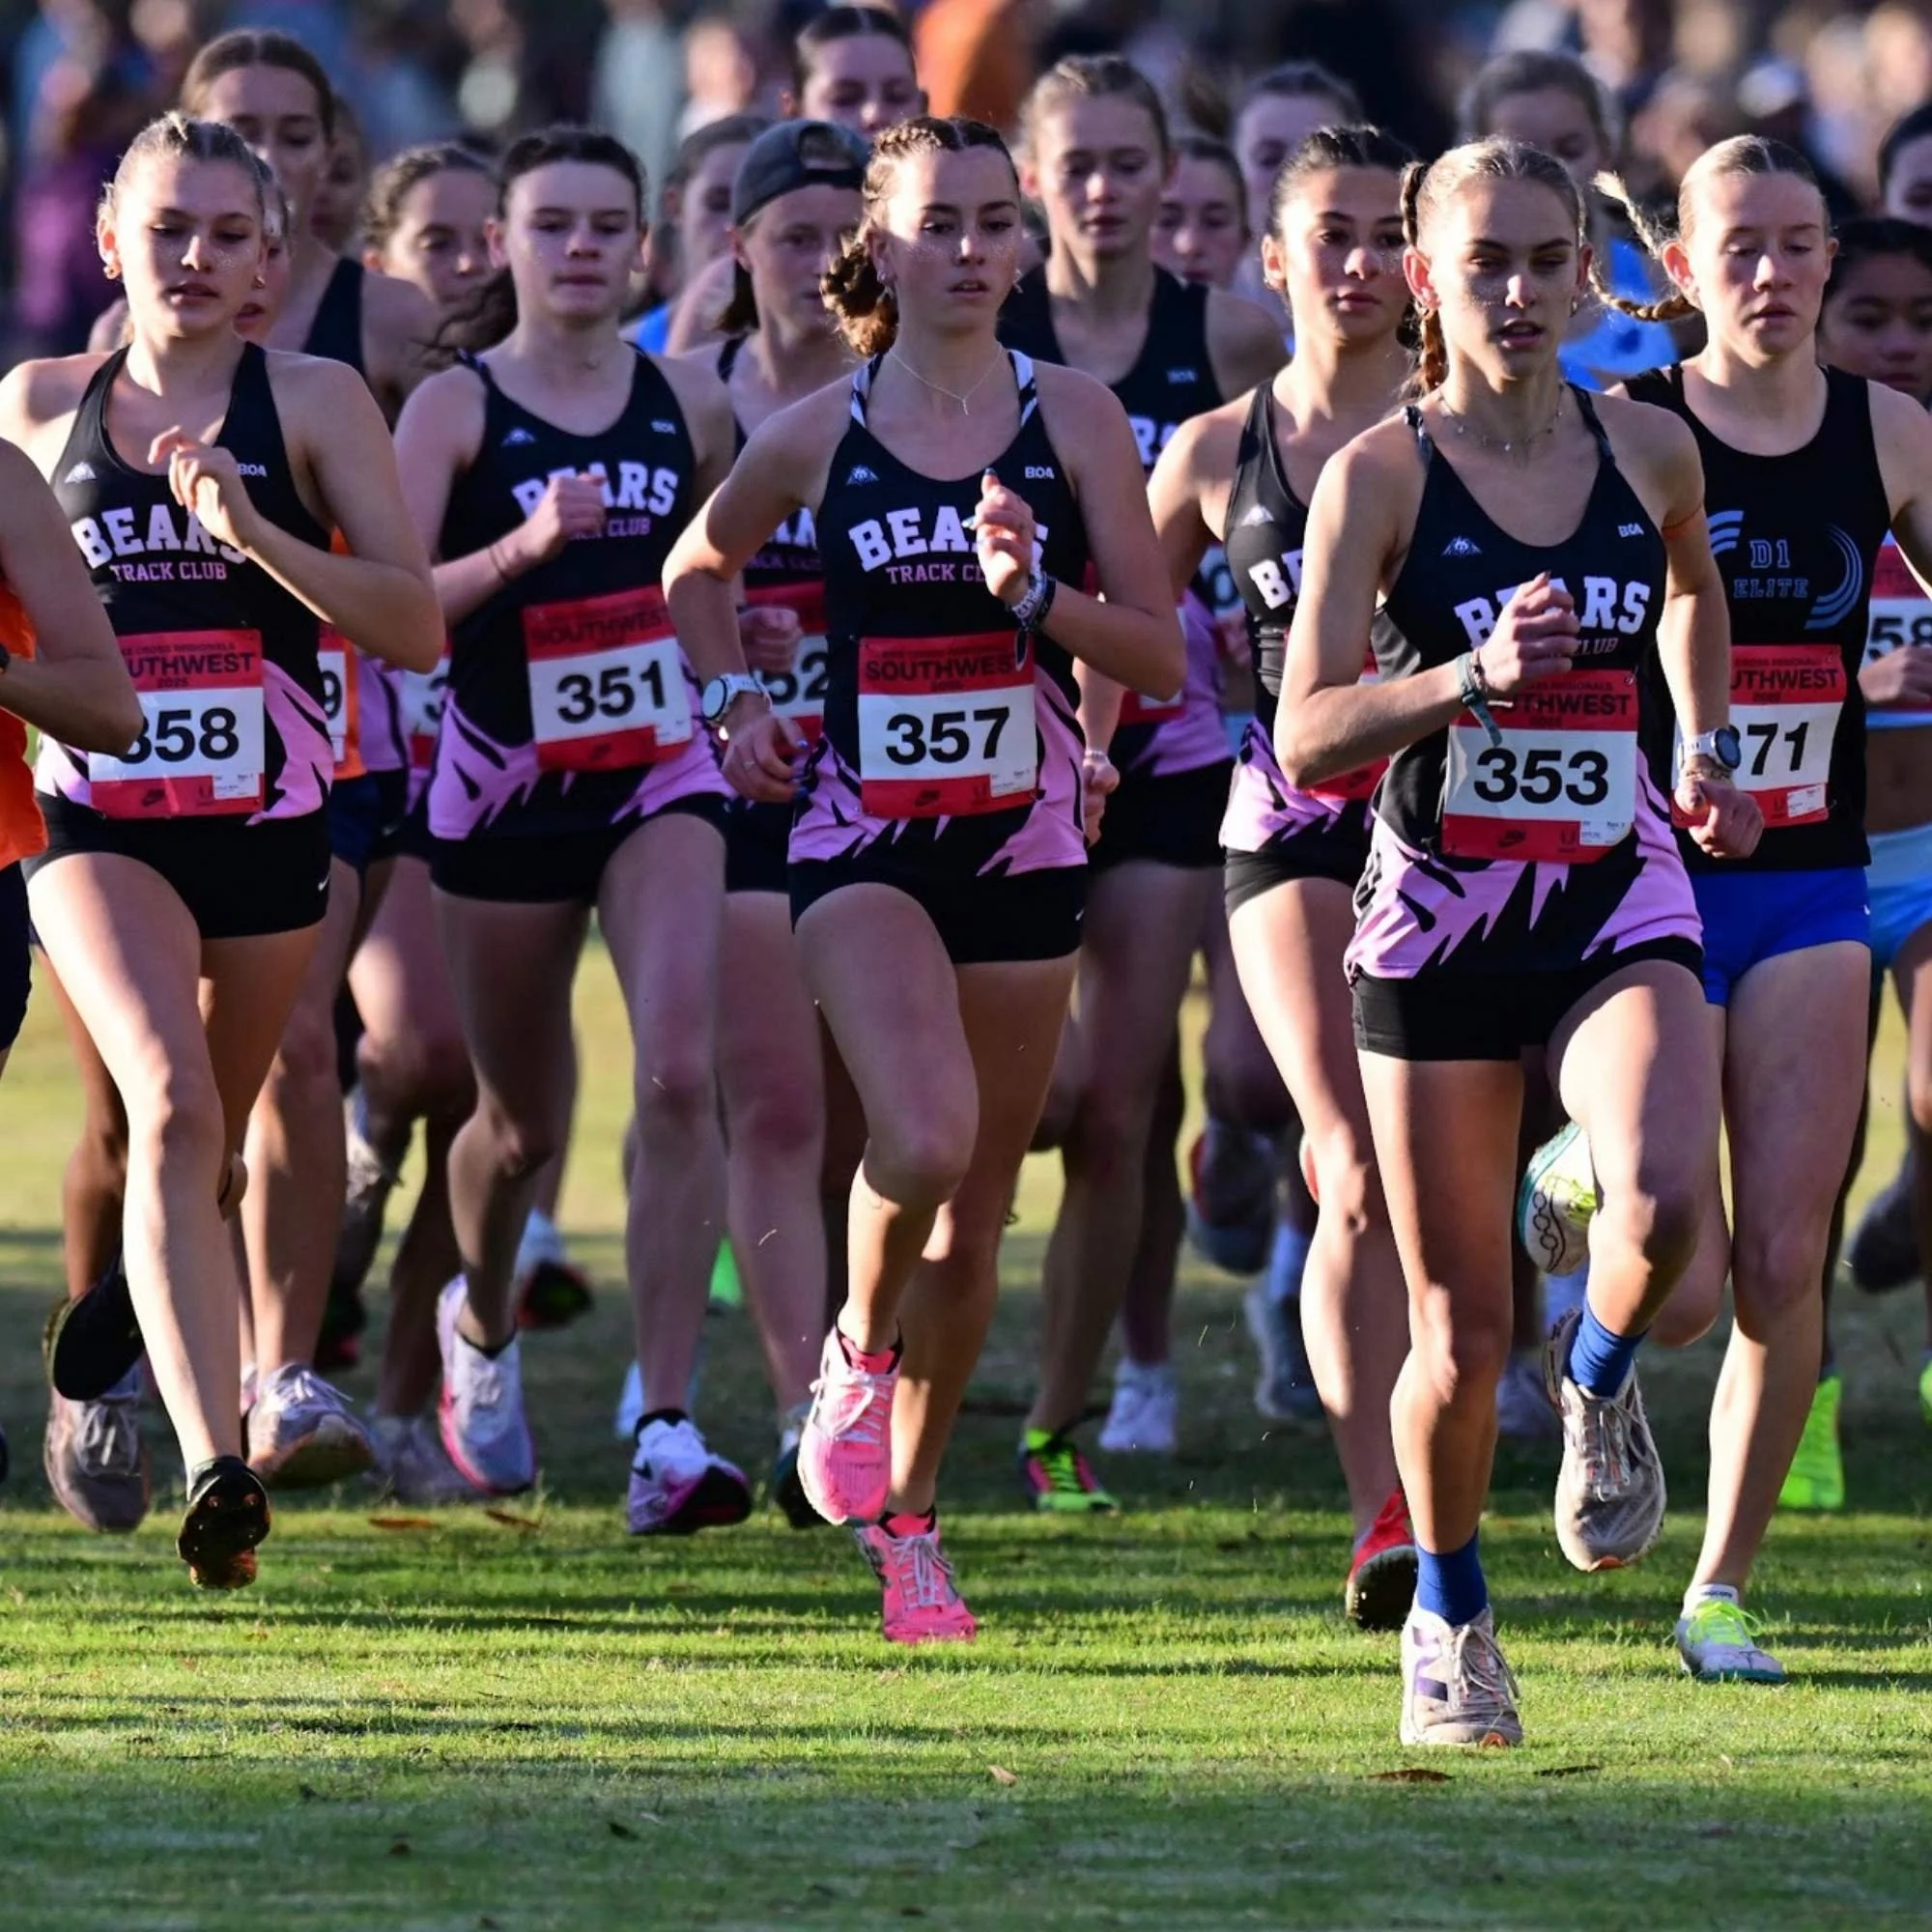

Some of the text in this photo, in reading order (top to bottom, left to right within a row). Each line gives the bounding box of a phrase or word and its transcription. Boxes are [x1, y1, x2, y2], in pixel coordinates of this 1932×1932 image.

[1025, 466, 1055, 479] BOA
[512, 461, 679, 523] BARS
[71, 504, 247, 570] BEAR
[607, 516, 651, 538] CLUB
[848, 505, 1049, 572] BEA
[1617, 523, 1644, 538] BOA
[1749, 539, 1790, 568] D1
[110, 561, 228, 582] TRACK CLUB
[885, 563, 988, 585] TRACK CL
[1733, 578, 1809, 598] ELITE
[1454, 576, 1651, 650] BRS
[1577, 637, 1619, 656] LUB
[127, 652, 254, 678] UTHWEST
[1731, 668, 1838, 690] THWEST
[556, 661, 666, 724] 351
[1507, 694, 1631, 716] THWEST
[886, 706, 1009, 766] 357
[1737, 722, 1809, 776] 71
[1473, 747, 1609, 806] 353
